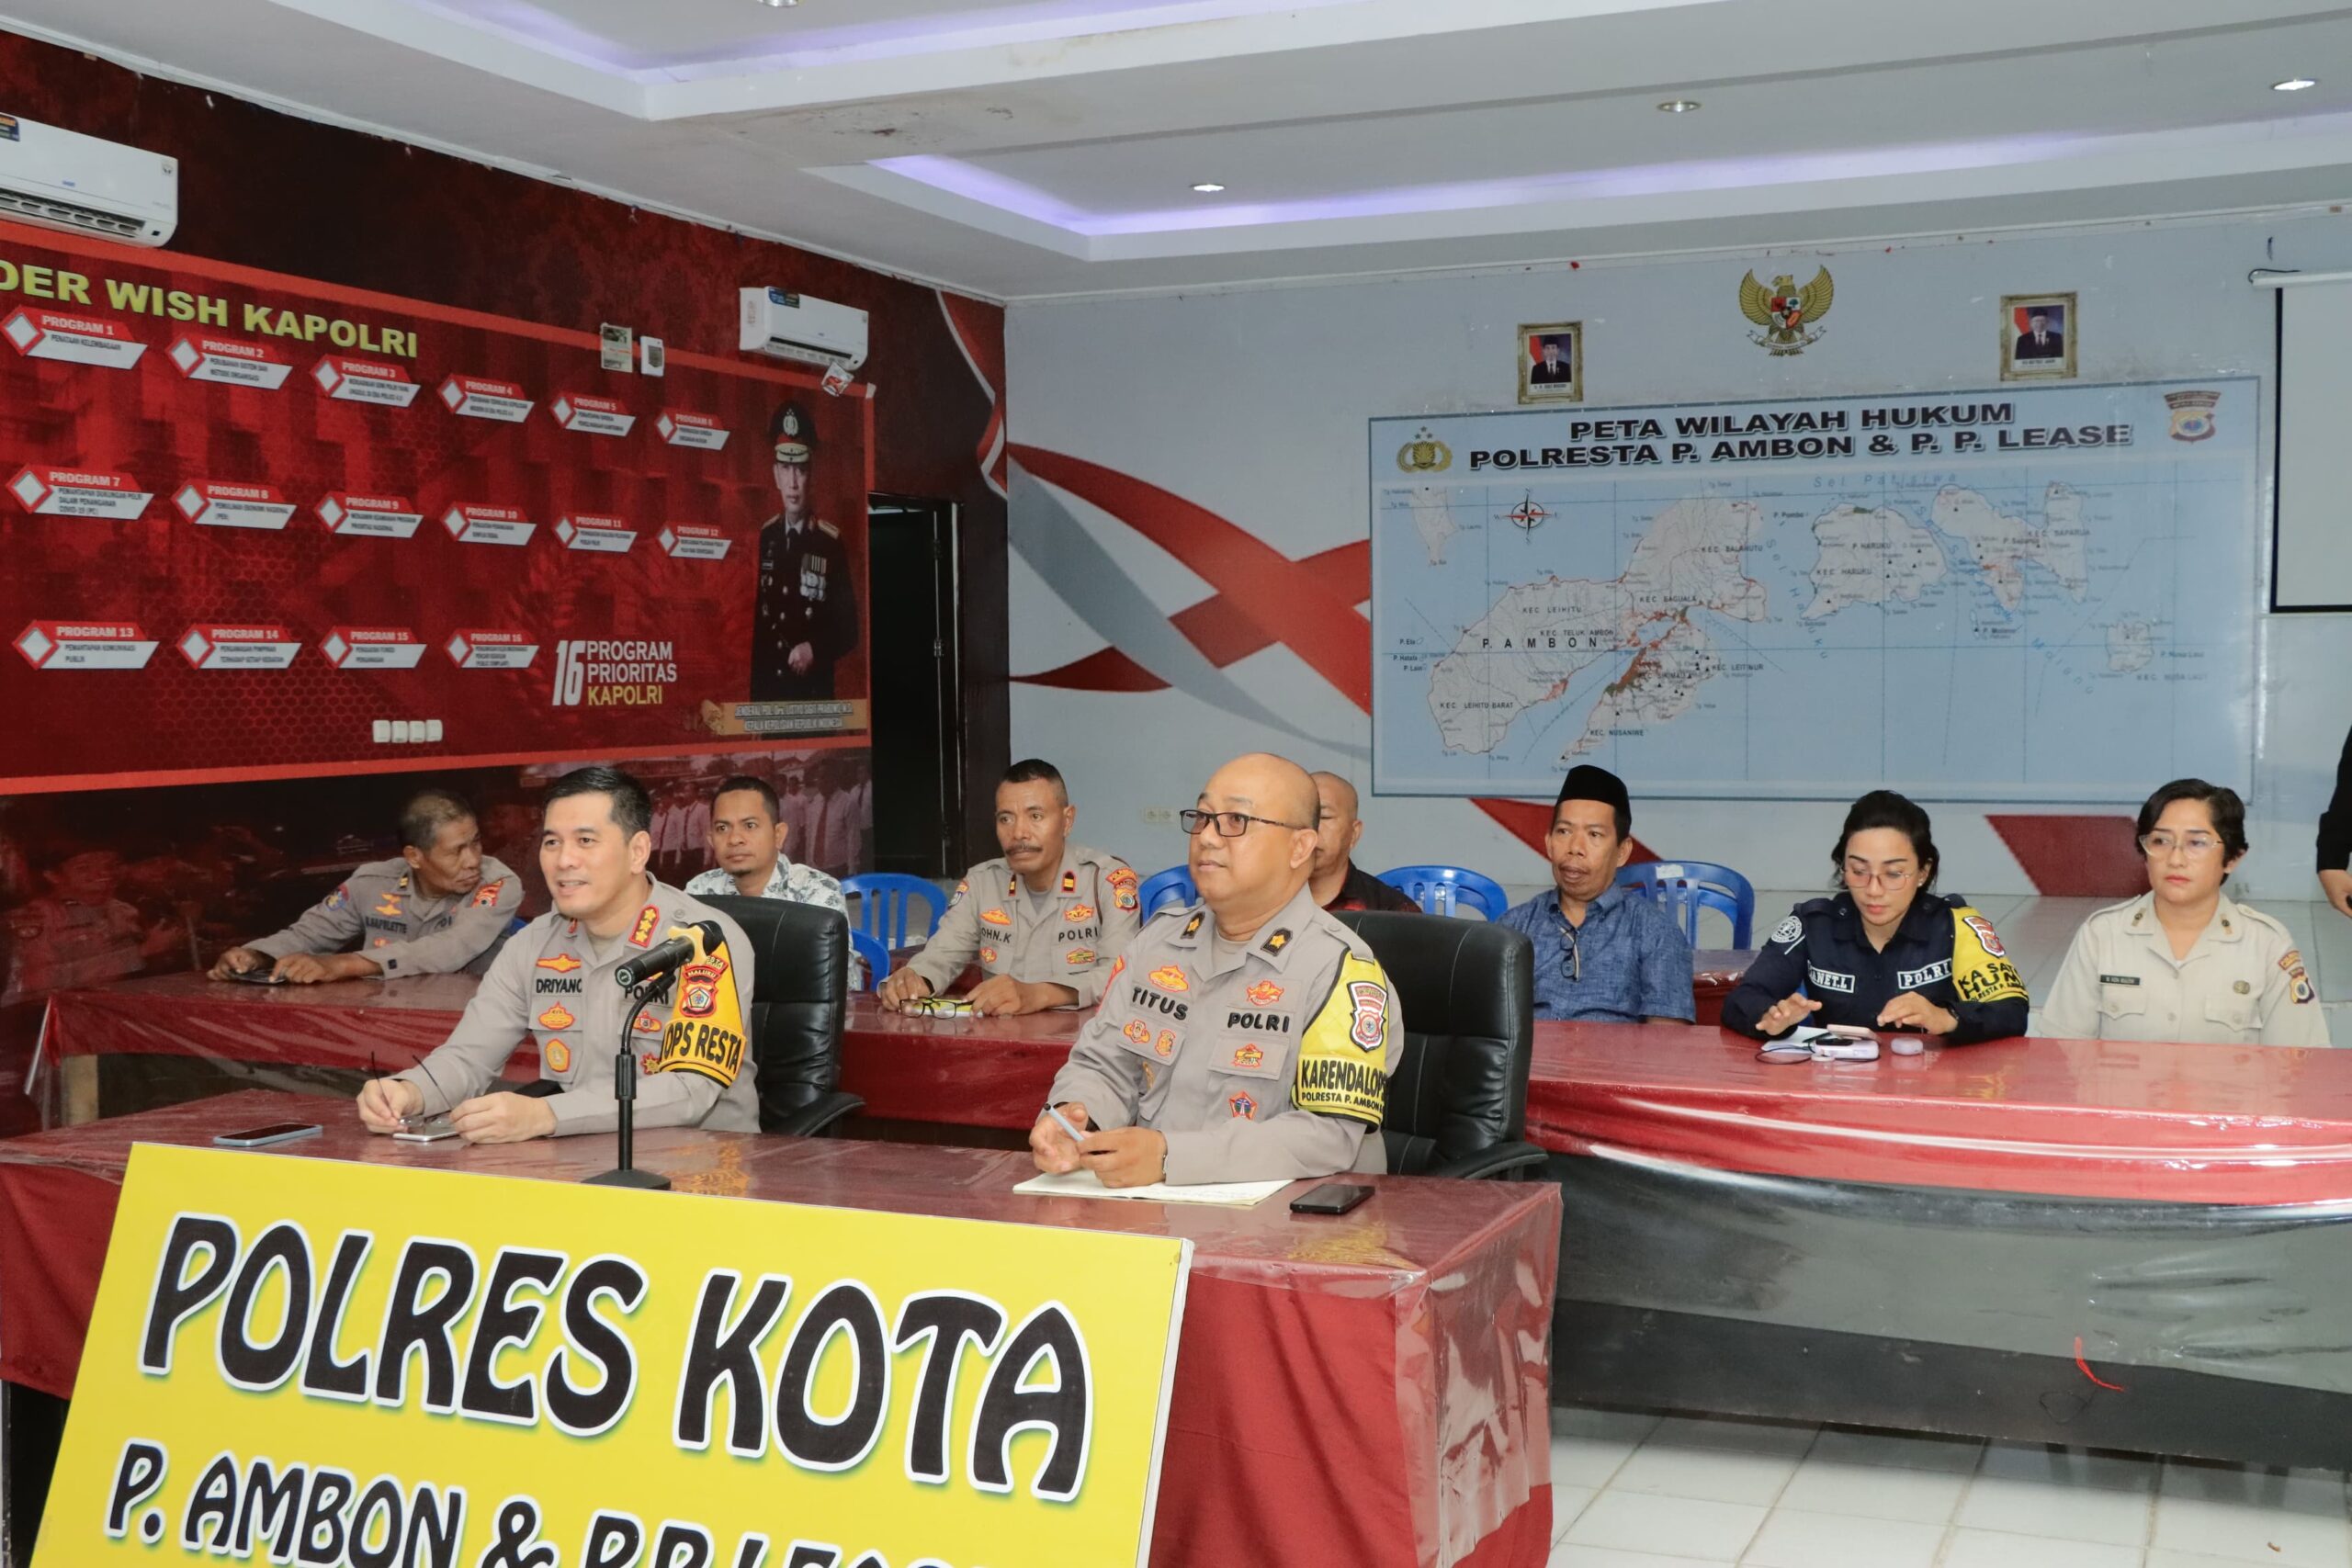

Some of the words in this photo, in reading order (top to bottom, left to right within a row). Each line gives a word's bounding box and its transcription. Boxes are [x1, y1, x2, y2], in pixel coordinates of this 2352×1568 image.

[0, 260, 92, 305] DER
[105, 278, 229, 328] WISH
[243, 303, 418, 358] KAPOLRI
[41, 315, 104, 334] PROGRAM
[107, 325, 115, 336] 1
[202, 340, 254, 356] PROGRAM
[256, 349, 265, 358] 2
[342, 362, 388, 378] PROGRAM
[390, 369, 396, 378] 3
[465, 380, 506, 394] PROGRAM
[506, 387, 513, 395] 4
[573, 397, 610, 410] PROGRAM
[611, 402, 616, 411] 5
[675, 413, 707, 425] PROGRAM
[1570, 419, 1664, 440] PETA
[1676, 411, 1847, 436] WILAYAH
[1861, 402, 2014, 428] HUKUM
[1470, 445, 1658, 469] POLRESTA
[1672, 443, 1699, 461] P.
[1711, 436, 1852, 460] AMBON
[1869, 434, 1896, 454] &
[1911, 433, 1939, 451] P.
[1954, 431, 1983, 449] P.
[1998, 423, 2131, 448] LEASE
[49, 471, 110, 486] PROGRAM
[113, 477, 120, 487] 7
[208, 485, 259, 499] PROGRAM
[261, 490, 268, 500] 8
[345, 497, 391, 509] PROGRAM
[392, 501, 399, 510] 9
[465, 507, 506, 518] PROGRAM
[507, 511, 517, 519] 10
[575, 516, 612, 527] PROGRAM
[613, 520, 622, 528] 11
[677, 525, 709, 536] PROGRAM
[710, 528, 718, 536] 12
[56, 626, 117, 637] PROGRAM
[119, 627, 134, 637] 13
[211, 628, 265, 639] PROGRAM
[266, 630, 279, 639] 14
[350, 631, 395, 641] PROGRAM
[397, 632, 409, 641] 15
[470, 633, 511, 642] PROGRAM
[512, 634, 522, 642] 16
[587, 640, 673, 660] PROGRAM
[552, 640, 586, 706] 16
[587, 662, 677, 683] PRIORITAS
[588, 684, 662, 706] KAPOLRI
[981, 928, 1012, 944] OHN.K
[1058, 928, 1099, 942] POLRI
[687, 968, 717, 978] MALUKU
[1904, 962, 1950, 987] POLRI
[1132, 987, 1188, 1021] TITUS
[1227, 1012, 1290, 1032] POLRI
[695, 1024, 742, 1075] RESTA
[1302, 1091, 1342, 1102] POLRESTA
[141, 1214, 647, 1432] POLRES
[676, 1272, 1091, 1498] KOTA
[107, 1440, 165, 1544] P.
[181, 1452, 466, 1568] AMBON
[480, 1495, 560, 1568] &
